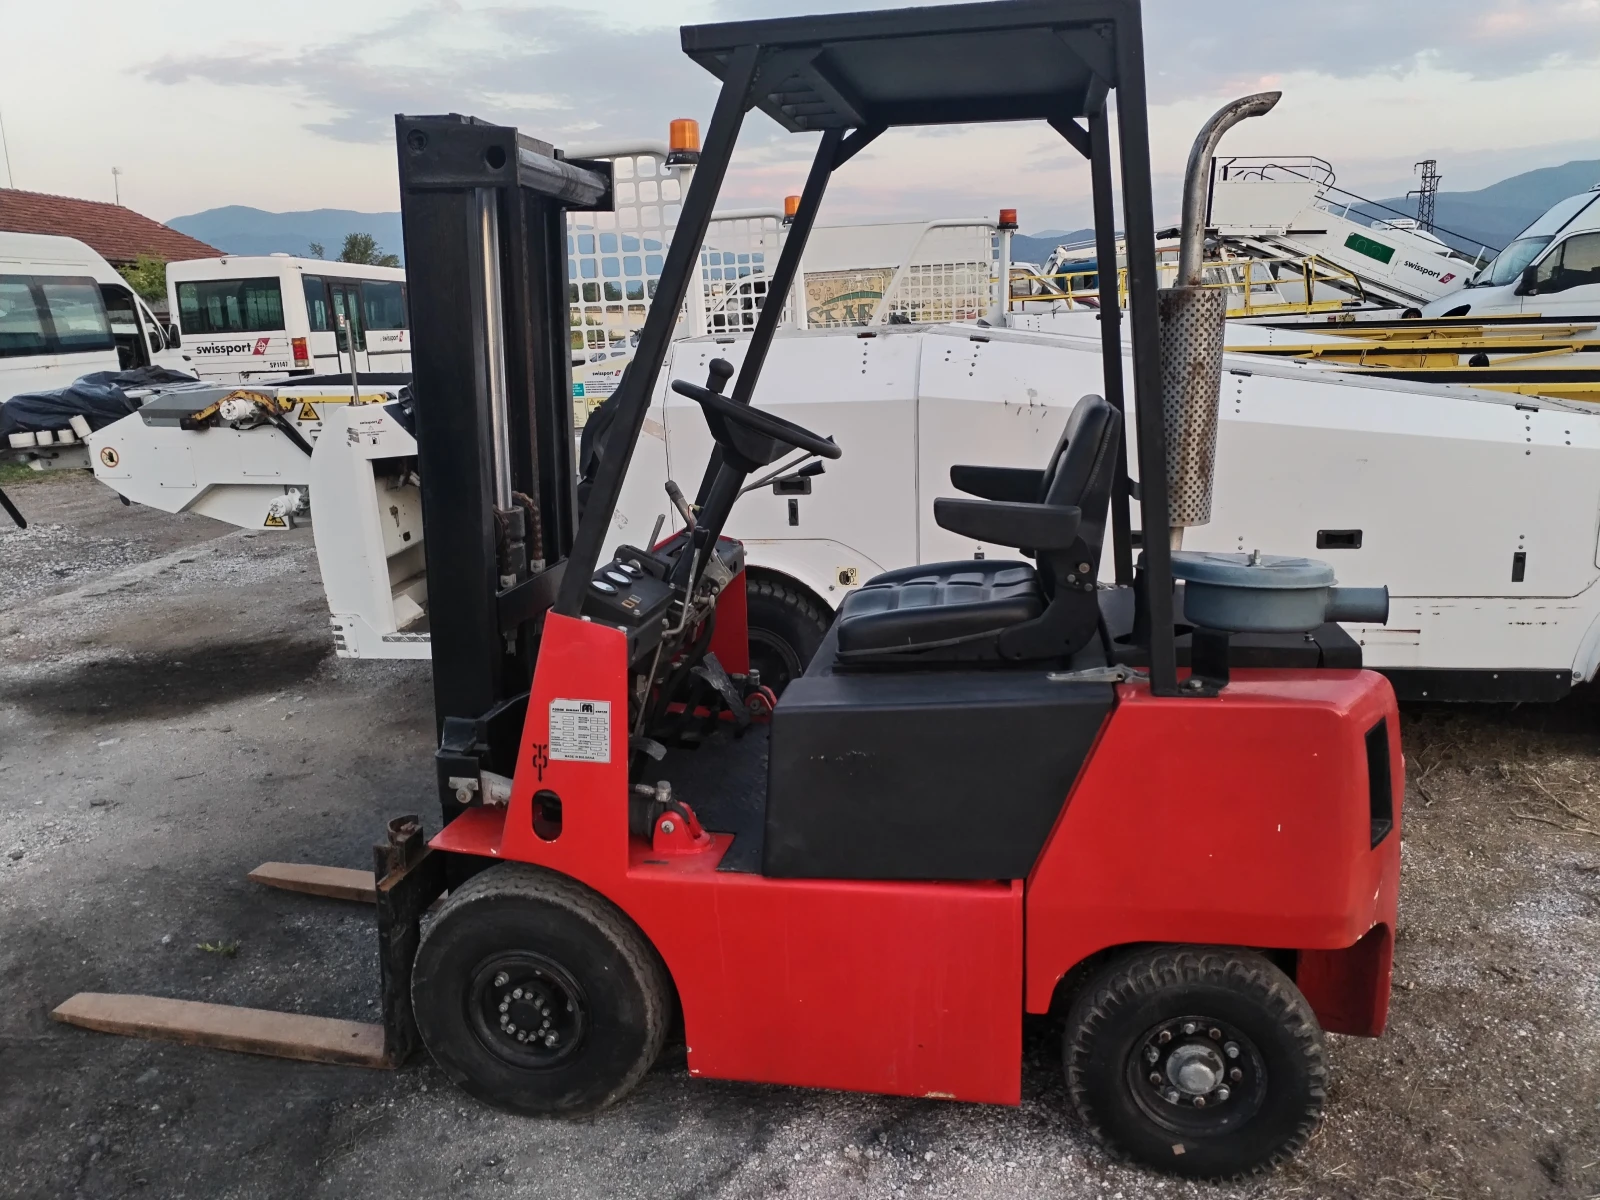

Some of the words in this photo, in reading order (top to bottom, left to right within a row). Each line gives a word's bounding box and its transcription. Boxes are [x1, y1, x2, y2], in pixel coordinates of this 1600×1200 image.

[1404, 261, 1441, 279] swissport
[382, 333, 399, 342] swissport
[196, 342, 252, 356] swissport
